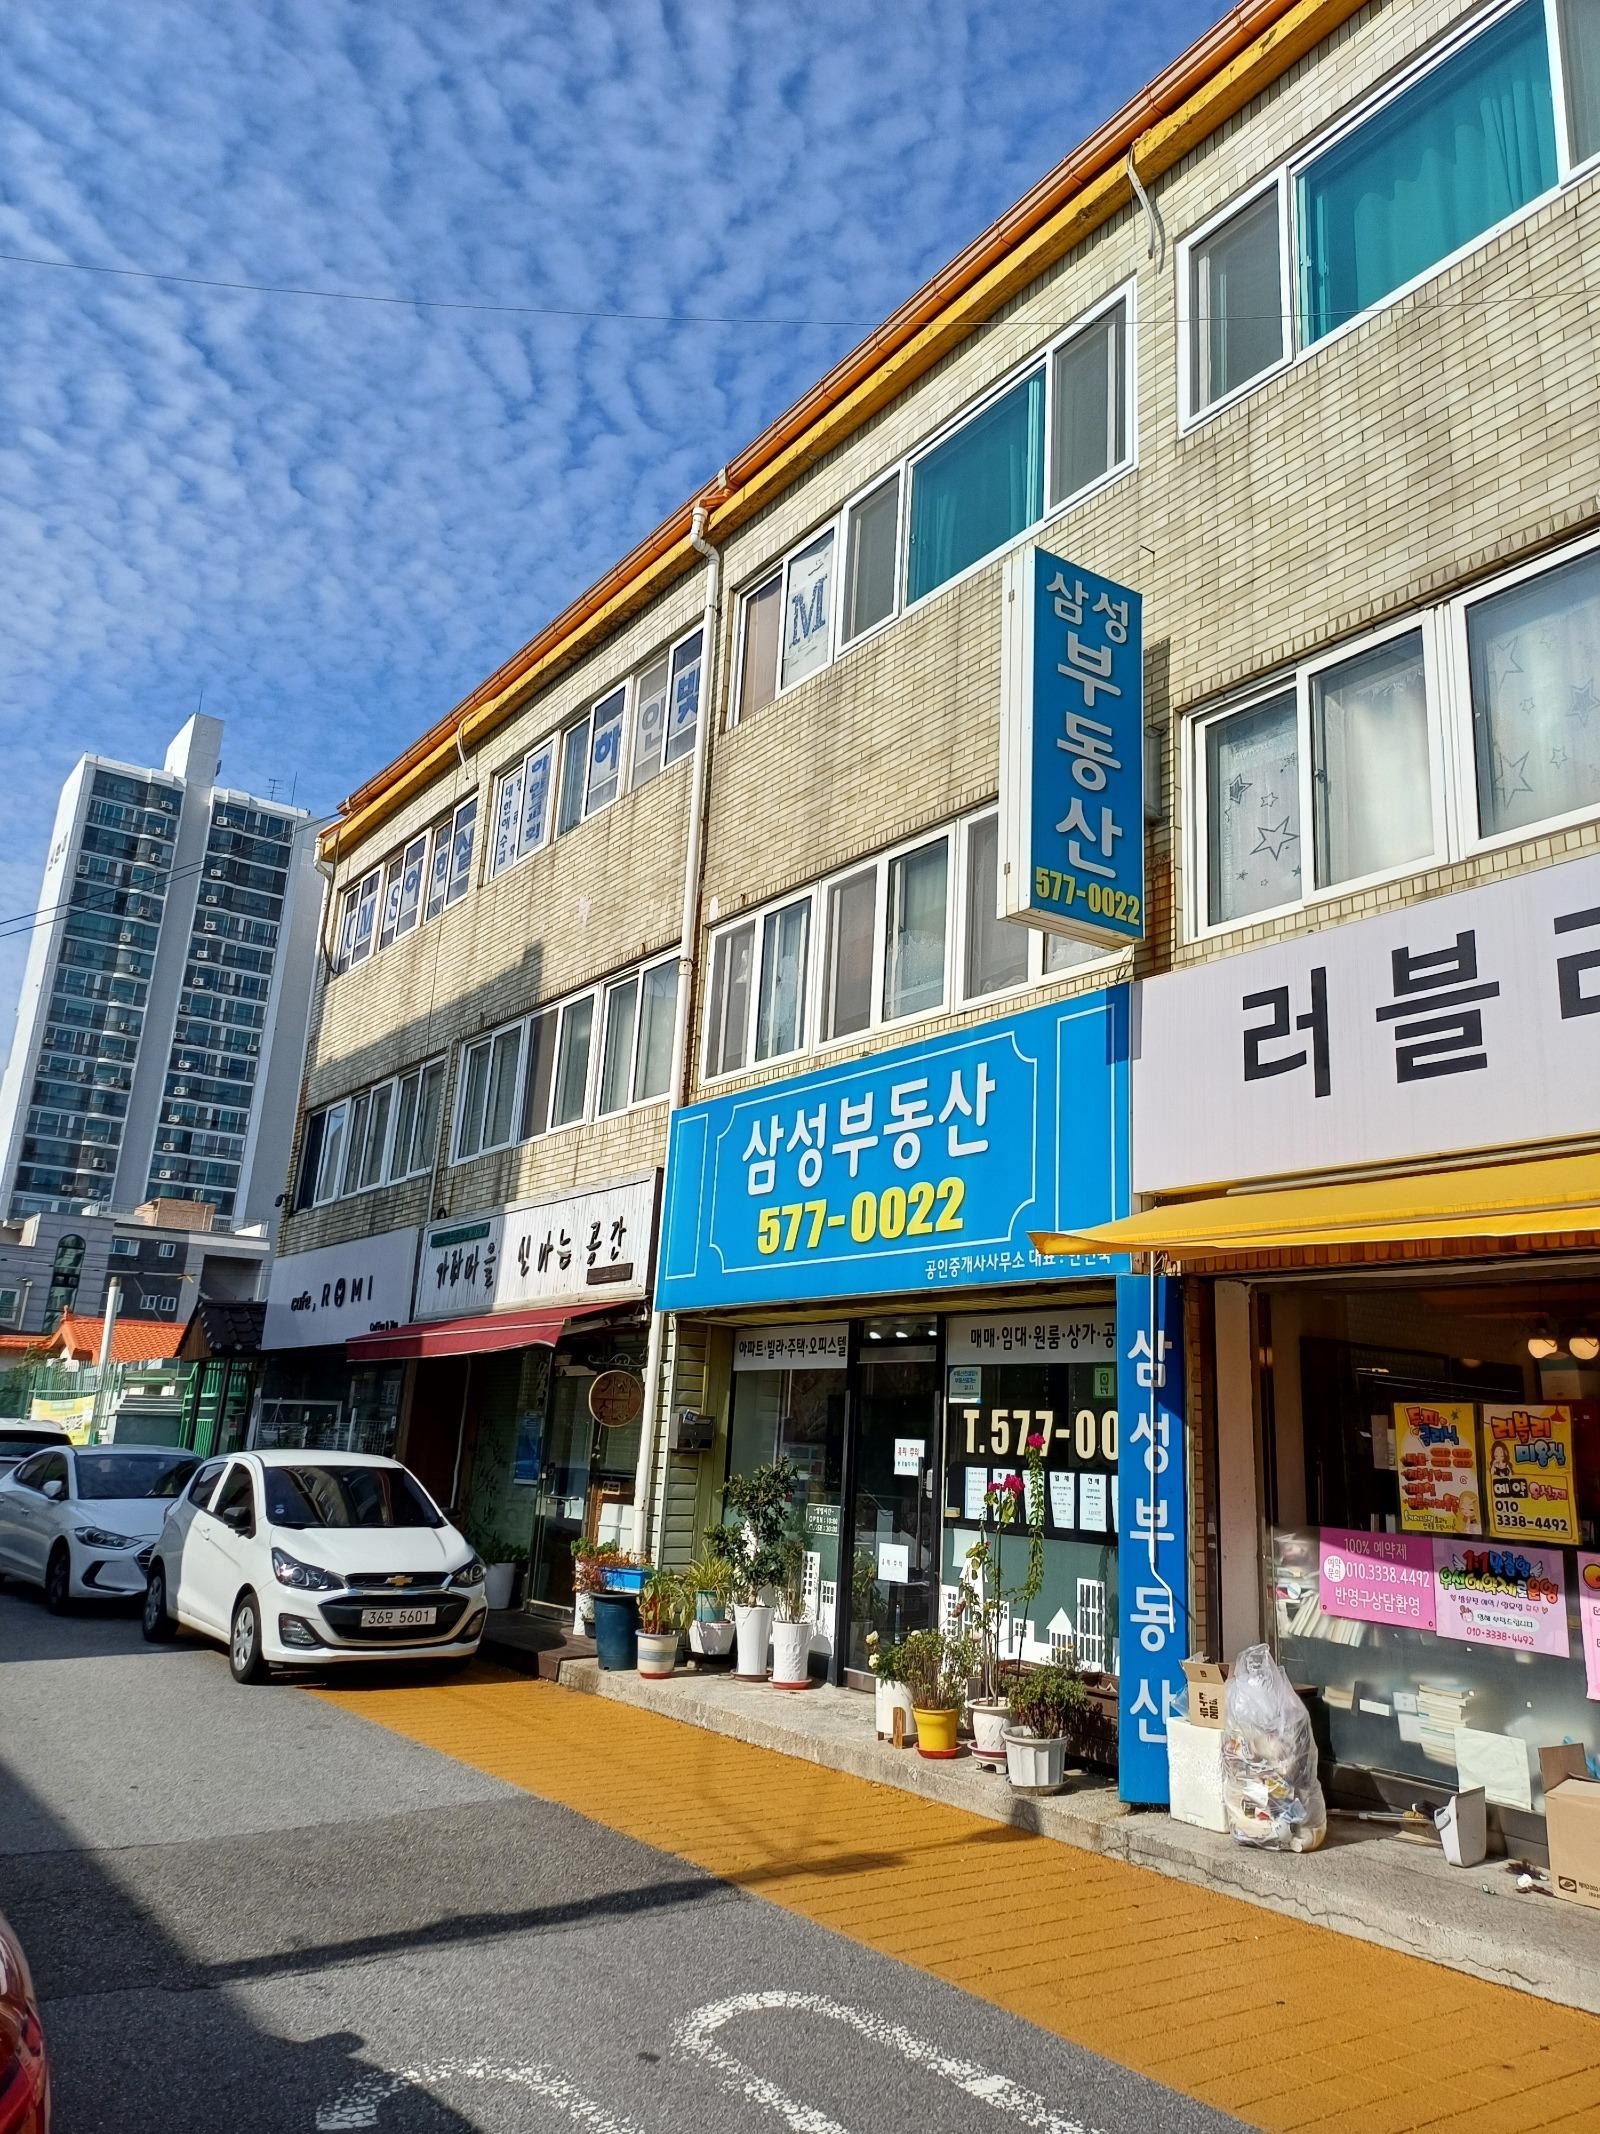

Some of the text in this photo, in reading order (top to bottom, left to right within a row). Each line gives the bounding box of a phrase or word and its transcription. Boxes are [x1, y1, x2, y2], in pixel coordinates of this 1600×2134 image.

[1045, 571, 1129, 644] 삼성
[1056, 631, 1122, 879] 부동산
[1035, 866, 1140, 926] 577-0022
[741, 1062, 996, 1197] 삼성부동산
[756, 1176, 966, 1255] 577-0022
[924, 1250, 1026, 1281] 공인중개사사무소
[1490, 1410, 1552, 1443] 러블리
[1514, 1439, 1566, 1468] 미용실
[1495, 1501, 1519, 1513] 010
[1496, 1514, 1569, 1531] 3338-4492
[1126, 1329, 1177, 1745] 삼성부동산
[1344, 1538, 1407, 1560] 100% 예약제
[1346, 1561, 1430, 1588] 010.3338.4492
[1335, 1586, 1420, 1616] 반영구상담환영
[399, 1610, 429, 1624] 5601
